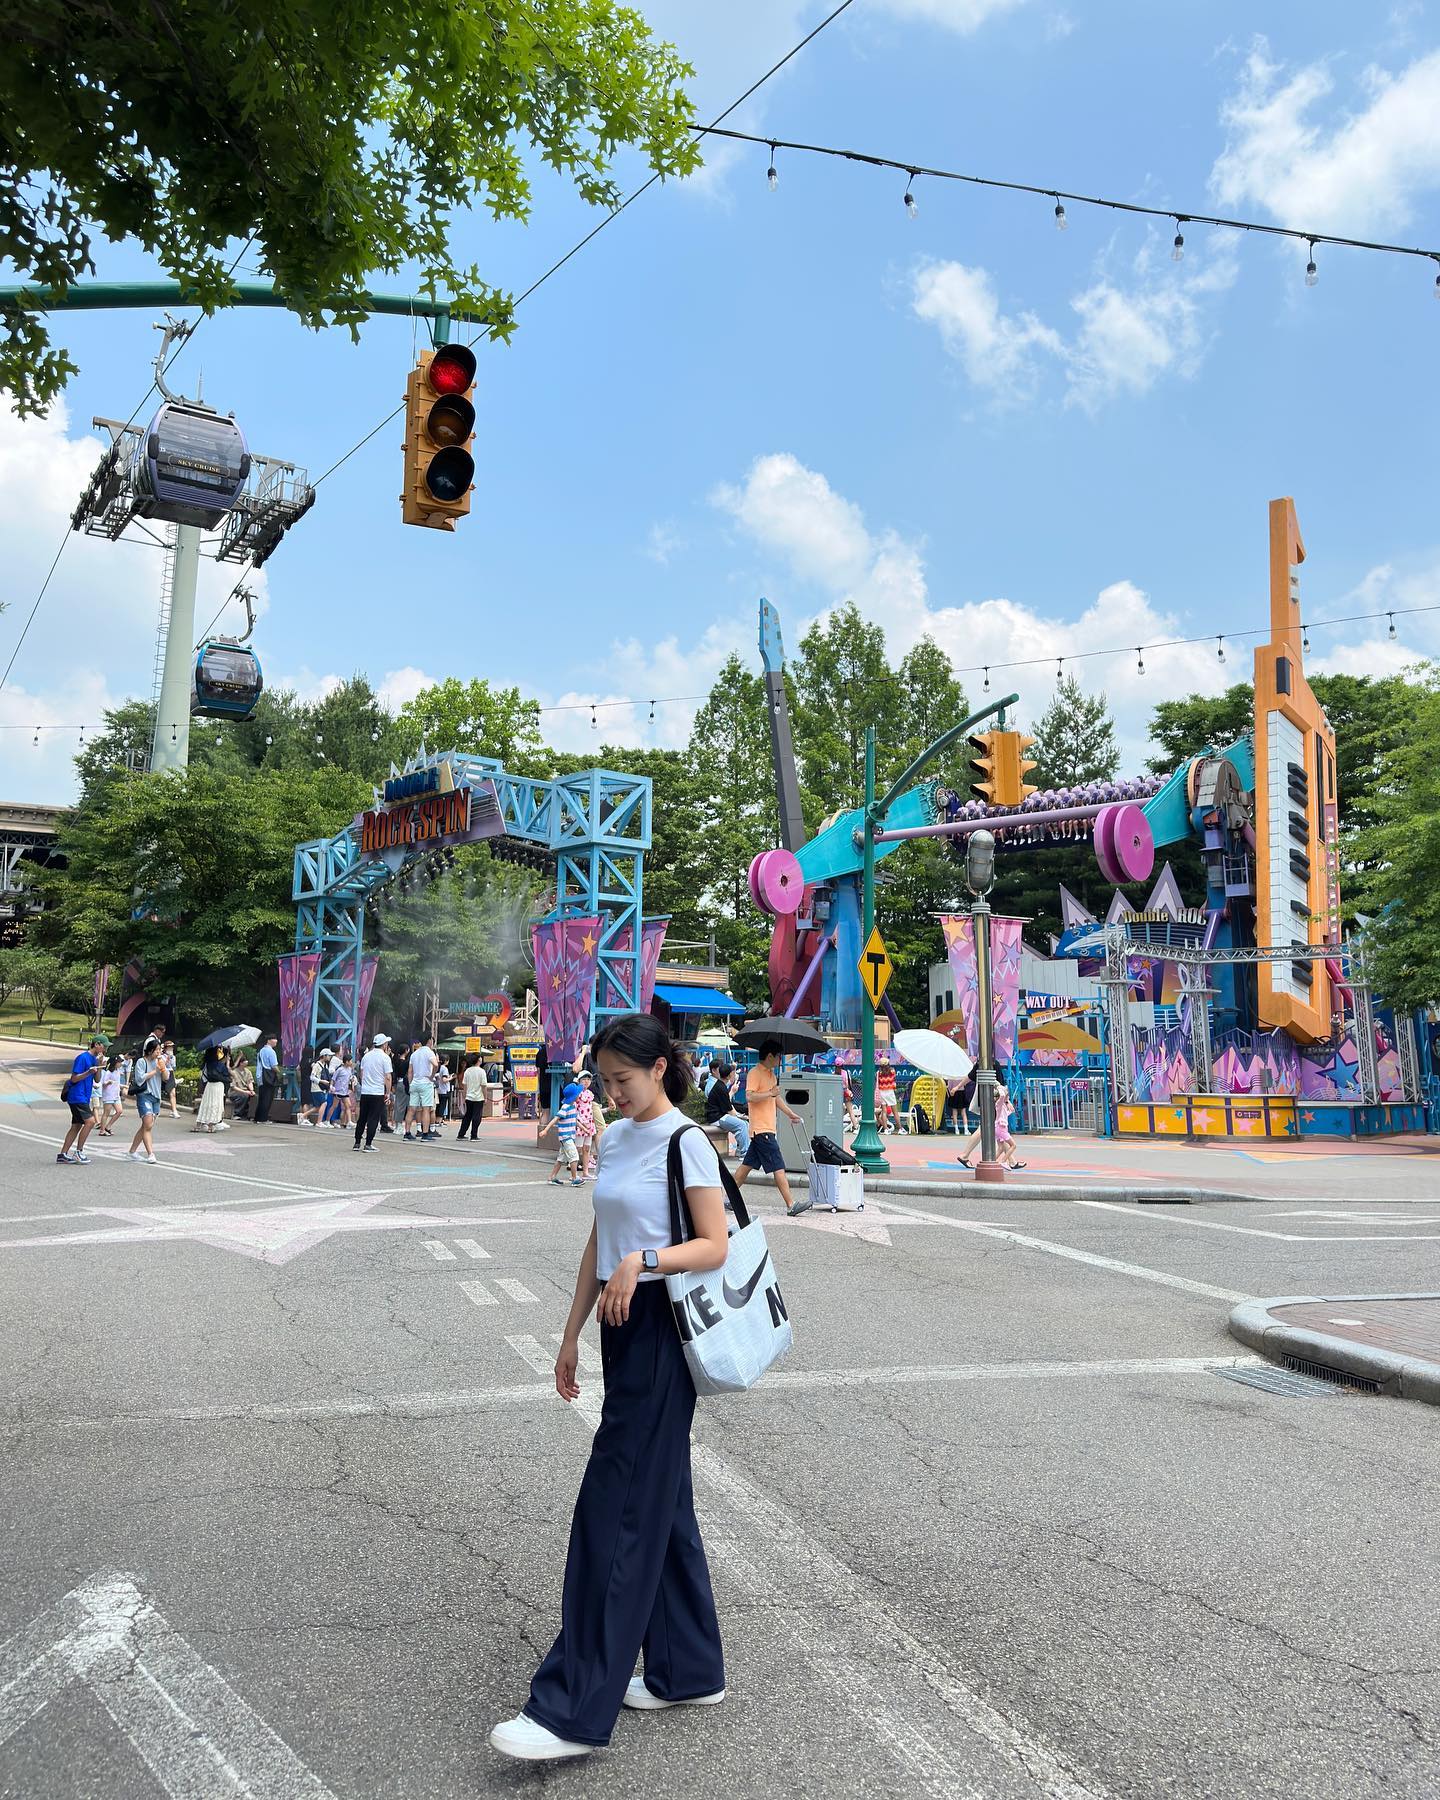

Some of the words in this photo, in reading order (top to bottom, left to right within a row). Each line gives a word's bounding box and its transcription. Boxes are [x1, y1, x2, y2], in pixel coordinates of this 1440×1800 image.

[177, 459, 193, 467] SKY
[194, 462, 219, 473] CRUISE
[384, 766, 440, 802] DOUBLE
[361, 808, 414, 853] ROCK
[418, 787, 472, 842] SPIN
[1124, 908, 1169, 923] Double
[449, 1001, 500, 1013] ENTRANCE
[1025, 995, 1047, 1009] WAY
[1050, 995, 1072, 1009] OUT
